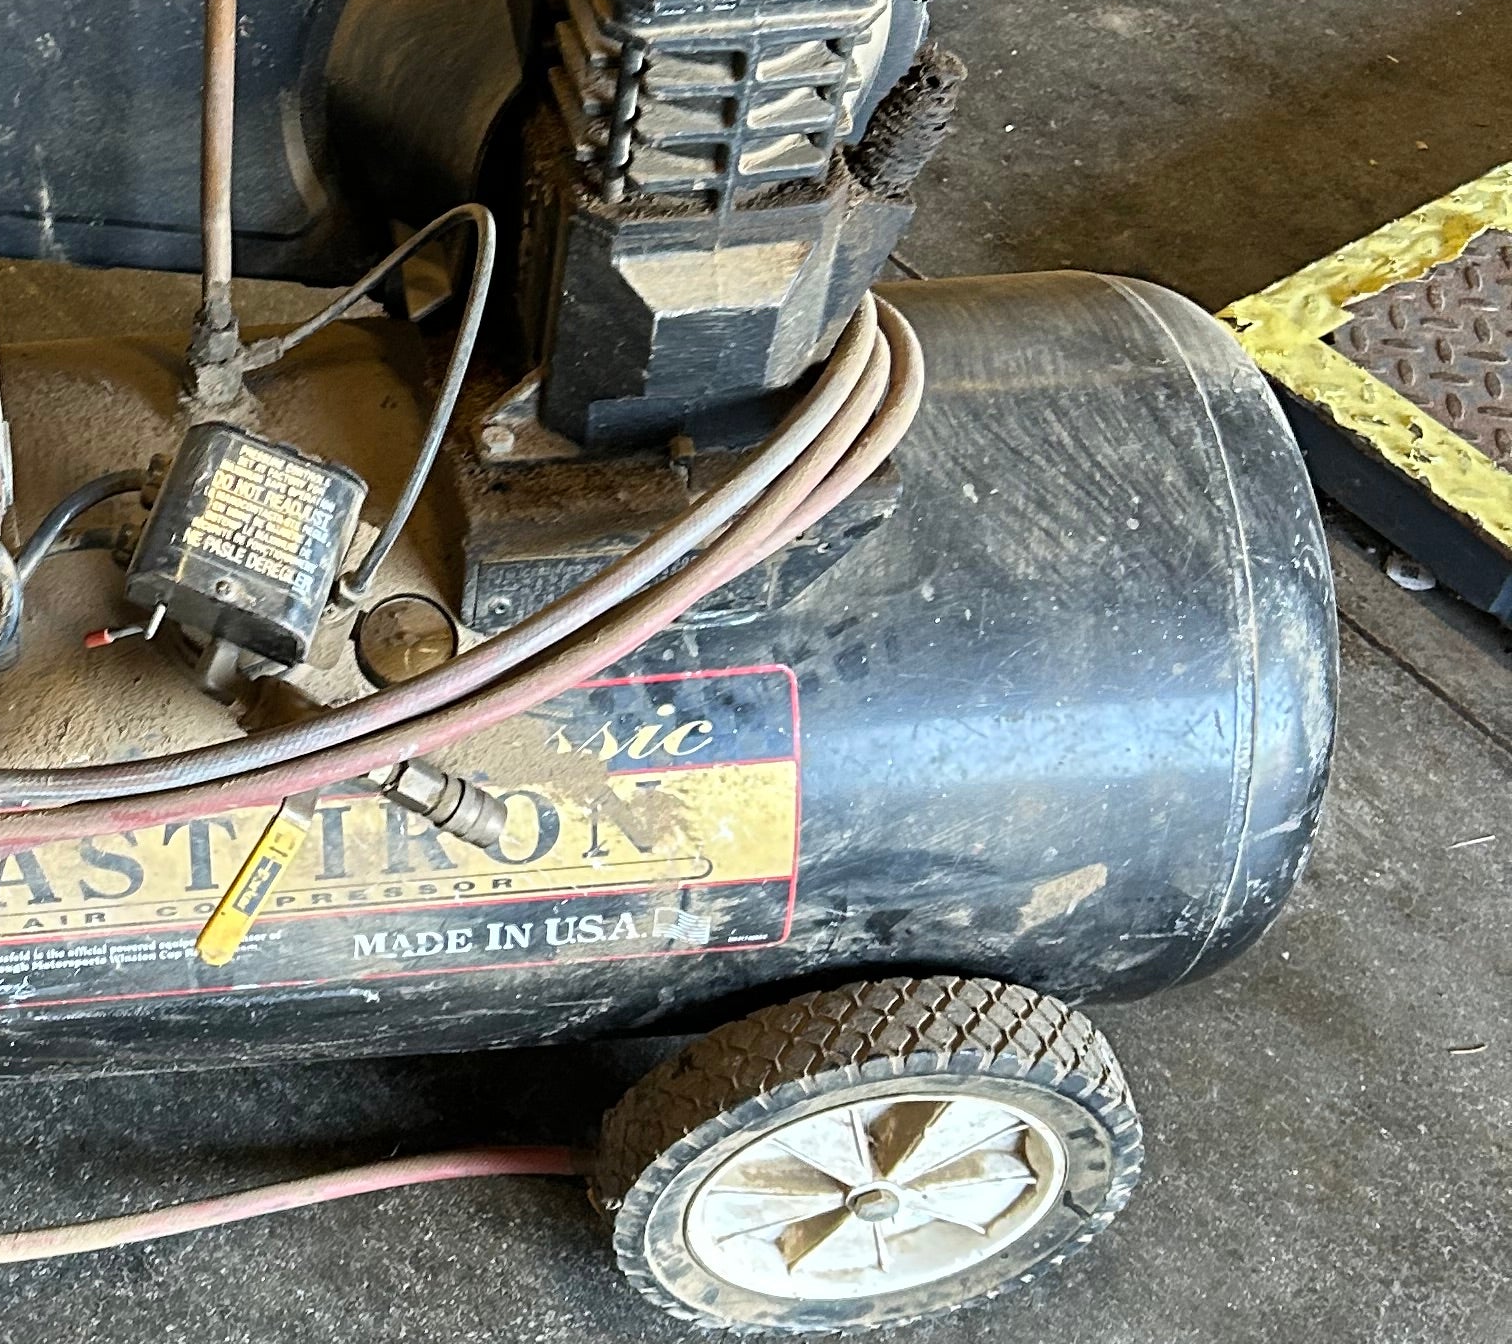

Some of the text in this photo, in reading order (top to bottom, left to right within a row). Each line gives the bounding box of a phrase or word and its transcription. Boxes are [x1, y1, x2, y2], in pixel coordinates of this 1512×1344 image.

[211, 468, 236, 491] DO
[233, 477, 265, 503] NOT
[262, 489, 333, 531] READJUST
[21, 911, 107, 930] AIR
[155, 877, 514, 918] COPRESSOR
[46, 948, 66, 959] the
[68, 943, 107, 957] official
[109, 940, 157, 954] powered
[159, 949, 183, 961] Cup
[353, 928, 473, 960] MADE
[485, 922, 535, 951] IN
